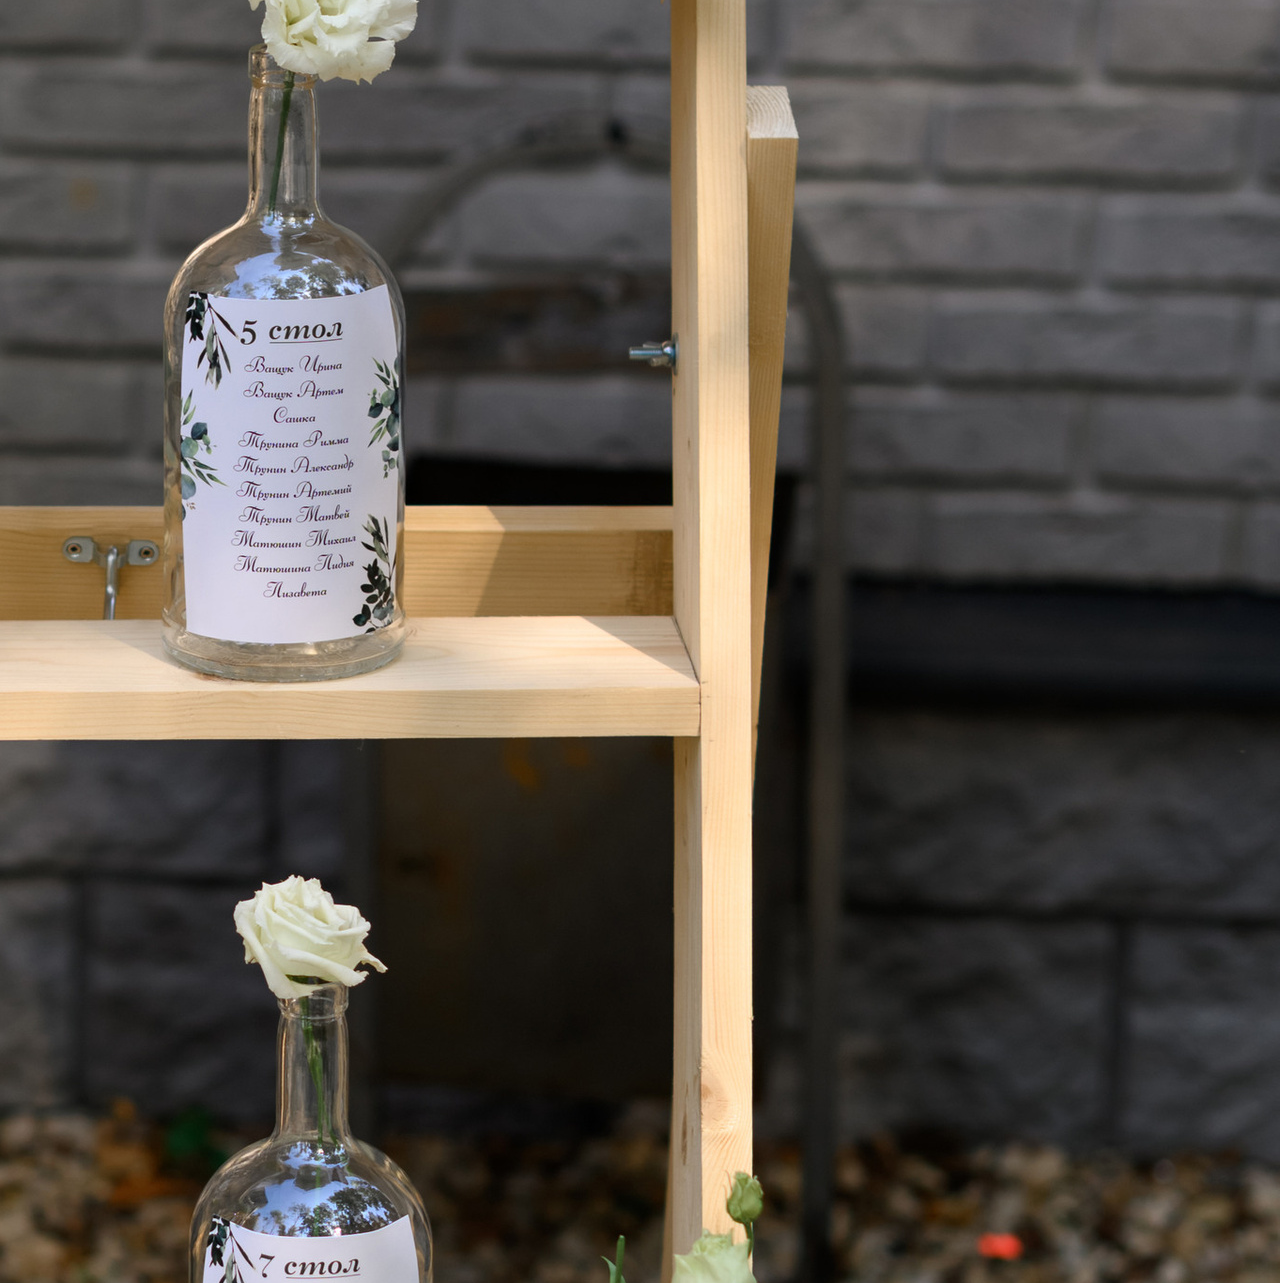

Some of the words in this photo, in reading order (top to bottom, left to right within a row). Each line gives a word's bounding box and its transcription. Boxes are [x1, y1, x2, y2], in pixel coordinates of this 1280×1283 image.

[240, 320, 257, 345] 5
[269, 322, 343, 340] стол
[244, 356, 294, 375] Ващук
[299, 354, 343, 374] Ирина
[243, 381, 293, 400] Ващук
[297, 380, 344, 399] Артем
[273, 406, 316, 424] Сашка
[238, 431, 299, 451] Трунина
[303, 430, 349, 447] Римма
[233, 455, 286, 476] Трунин
[290, 454, 354, 474] Александр
[236, 480, 289, 501] Трунин
[293, 481, 352, 500] Артемий
[238, 506, 292, 526] Трунин
[296, 504, 350, 523] Матвей
[231, 530, 302, 548] Матюшин
[305, 529, 356, 547] Михаил
[233, 555, 311, 573] Матюшина
[314, 553, 354, 571] Лидия
[263, 581, 327, 598] Лизавета
[259, 1253, 275, 1278] 7
[284, 1258, 360, 1276] стол
